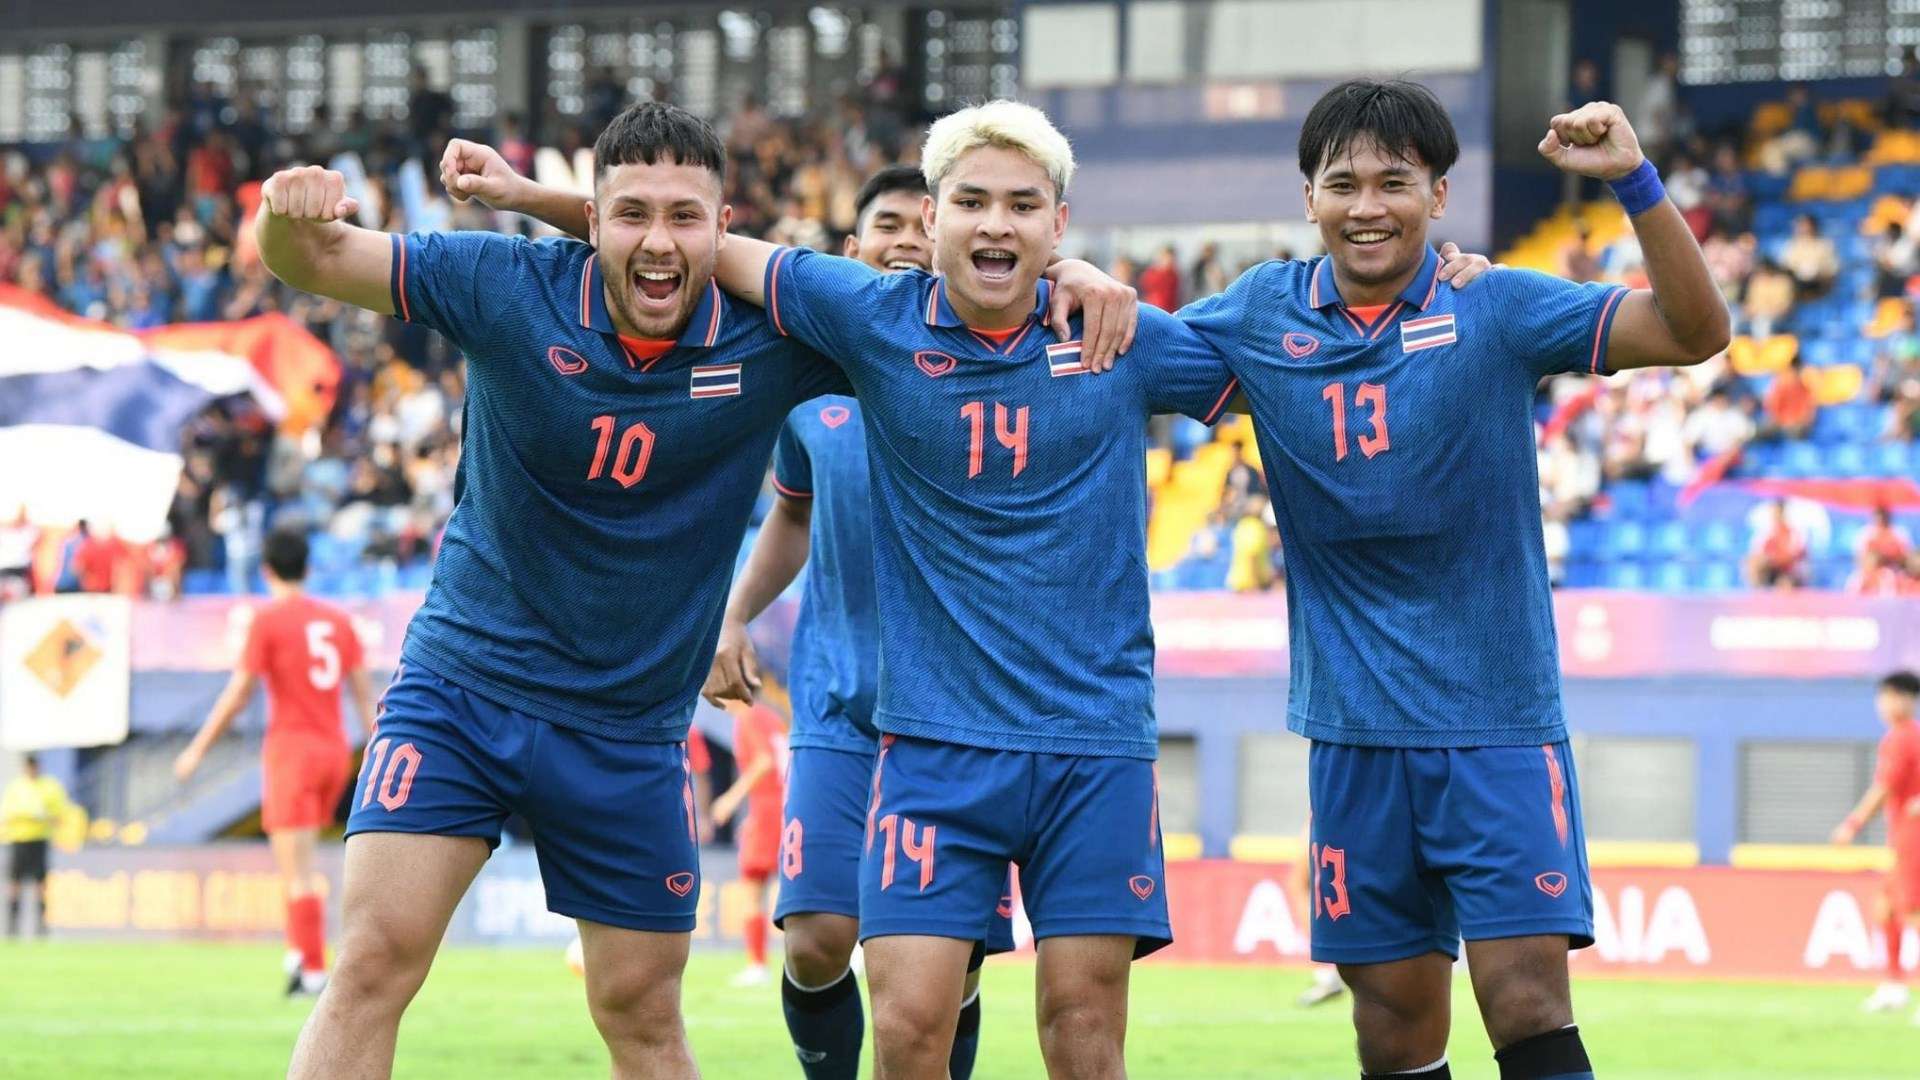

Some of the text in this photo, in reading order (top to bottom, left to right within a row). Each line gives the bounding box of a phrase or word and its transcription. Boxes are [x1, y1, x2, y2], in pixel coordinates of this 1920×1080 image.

[587, 415, 656, 489] 10
[960, 401, 1029, 479] 14
[1322, 383, 1390, 462] 13
[305, 620, 341, 691] 5
[361, 738, 423, 812] 10
[879, 814, 936, 892] 14
[1311, 842, 1351, 921] 13
